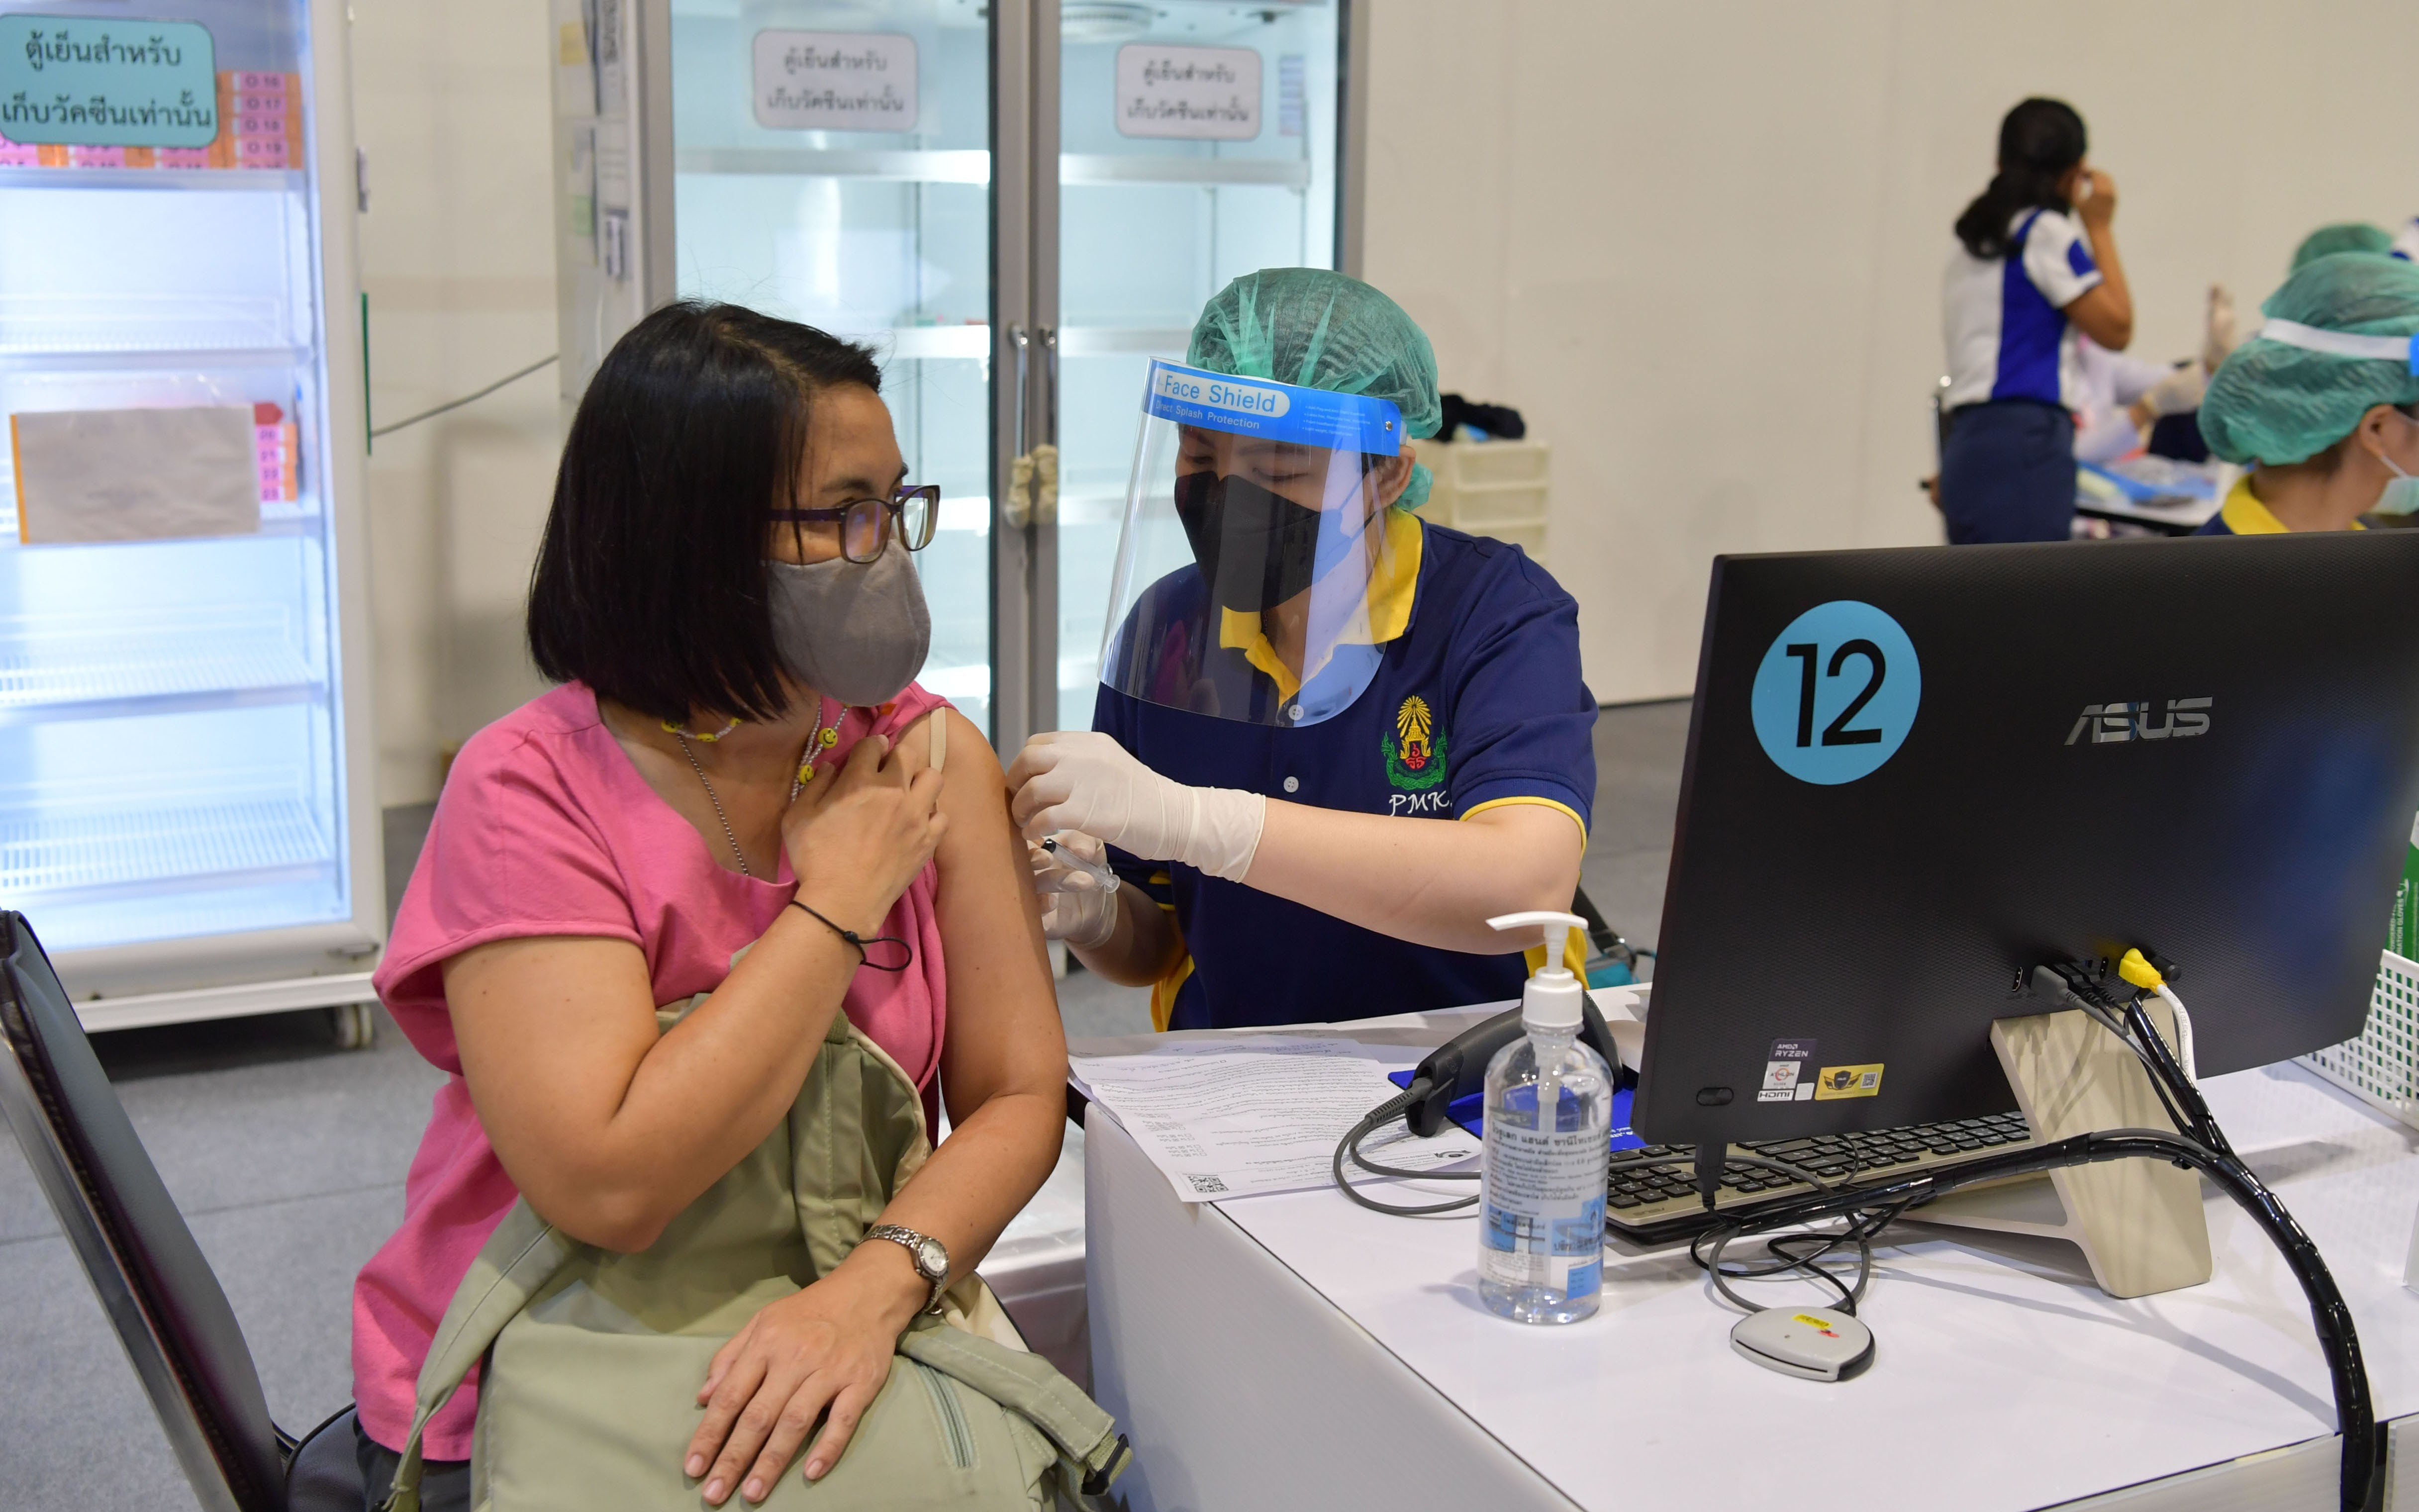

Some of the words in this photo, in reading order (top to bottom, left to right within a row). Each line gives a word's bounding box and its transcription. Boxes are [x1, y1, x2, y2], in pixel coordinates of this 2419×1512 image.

[26, 30, 181, 71] ตู้เย็นสำหรับ
[784, 47, 887, 75] ตู้เย็นสำหรับ
[1, 90, 211, 127] เก็บวัคซีนเท่านั้น
[1164, 375, 1200, 399] Face
[1209, 384, 1276, 412] Shield
[1175, 404, 1203, 419] Splash
[1208, 412, 1260, 429] Protection
[1787, 639, 1886, 748] 12
[2064, 697, 2213, 746] ASUS
